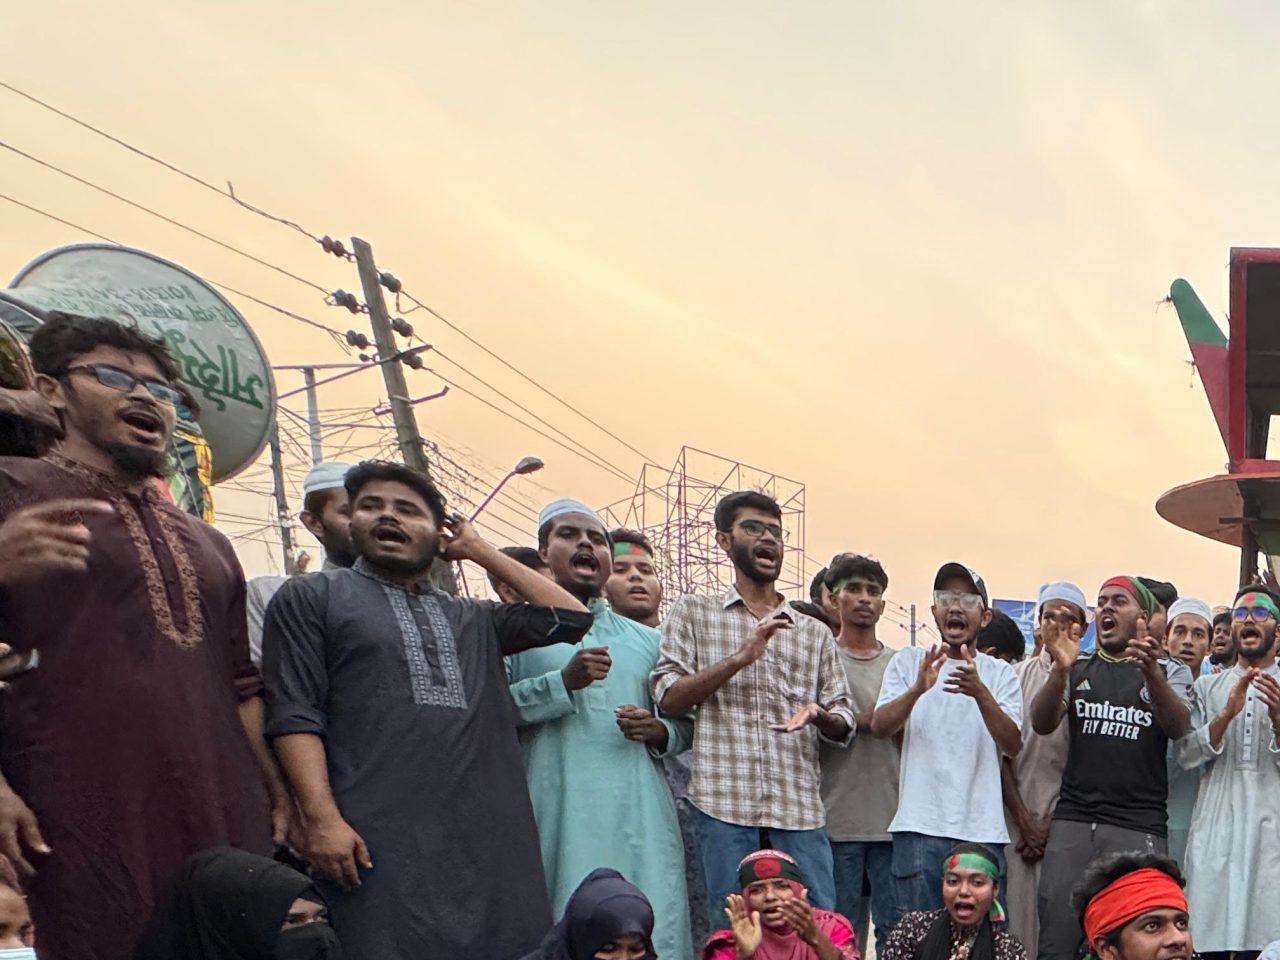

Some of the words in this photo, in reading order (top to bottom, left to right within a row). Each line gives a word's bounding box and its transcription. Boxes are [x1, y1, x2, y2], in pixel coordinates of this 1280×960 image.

[1075, 698, 1152, 727] Emirates
[1082, 719, 1099, 734] FLY
[1100, 721, 1140, 740] BETTER
